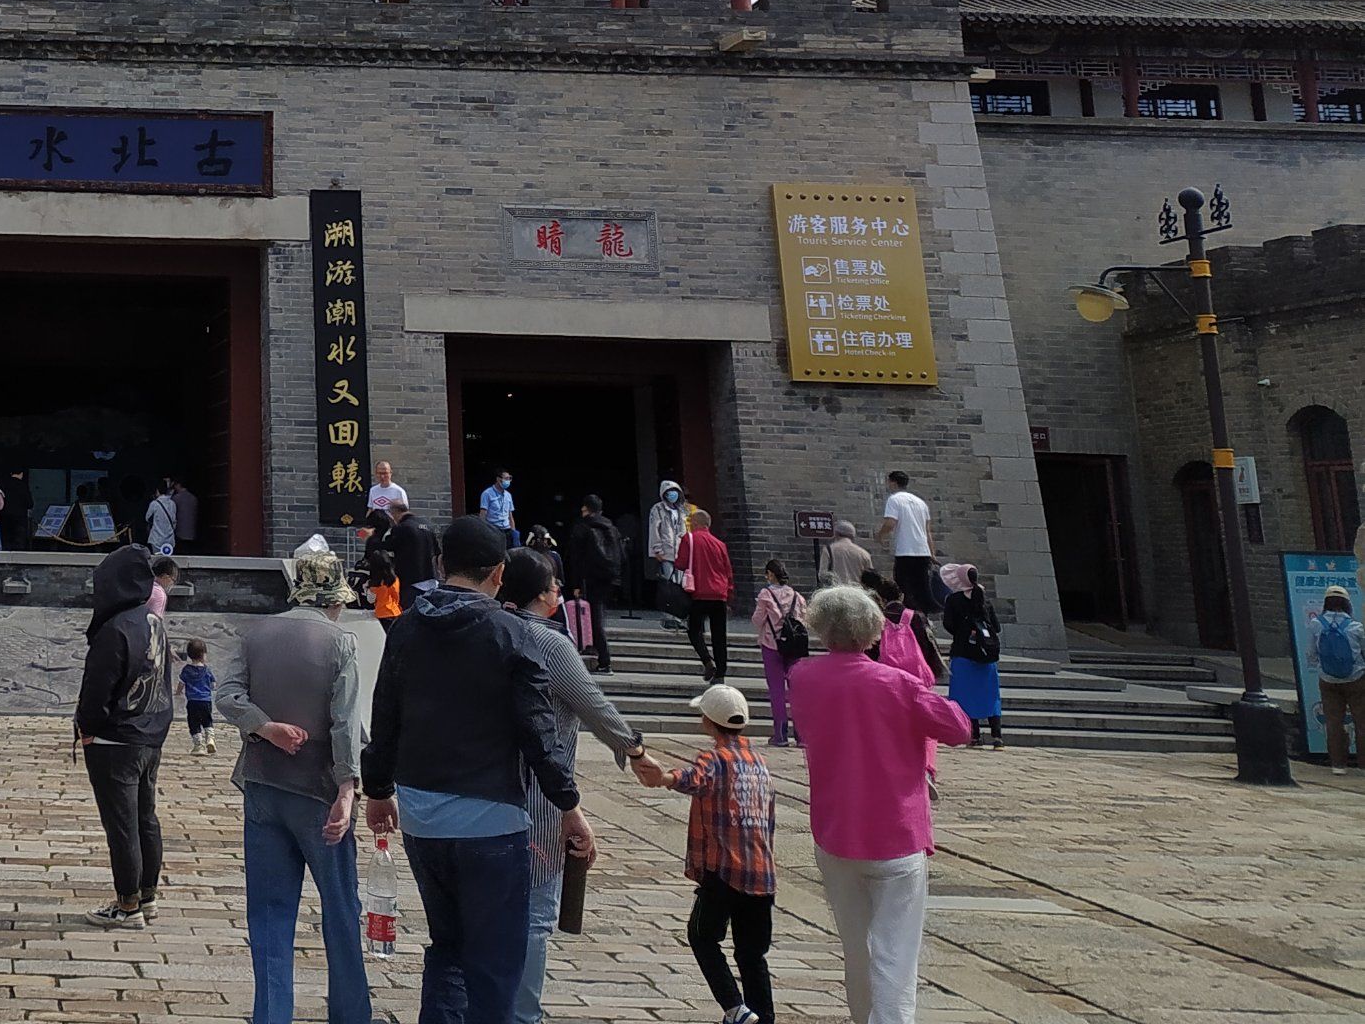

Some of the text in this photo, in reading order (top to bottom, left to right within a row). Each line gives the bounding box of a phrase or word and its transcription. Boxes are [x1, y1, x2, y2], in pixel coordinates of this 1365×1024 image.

[788, 213, 910, 236] 游客服务中心
[831, 237, 867, 246] Service
[871, 238, 904, 247] Center
[834, 259, 887, 276] 售票处
[836, 277, 869, 285] Ticketing
[837, 294, 891, 312] 检票处
[840, 312, 906, 322] Ticketing Checking
[841, 330, 914, 348] 住宿办理
